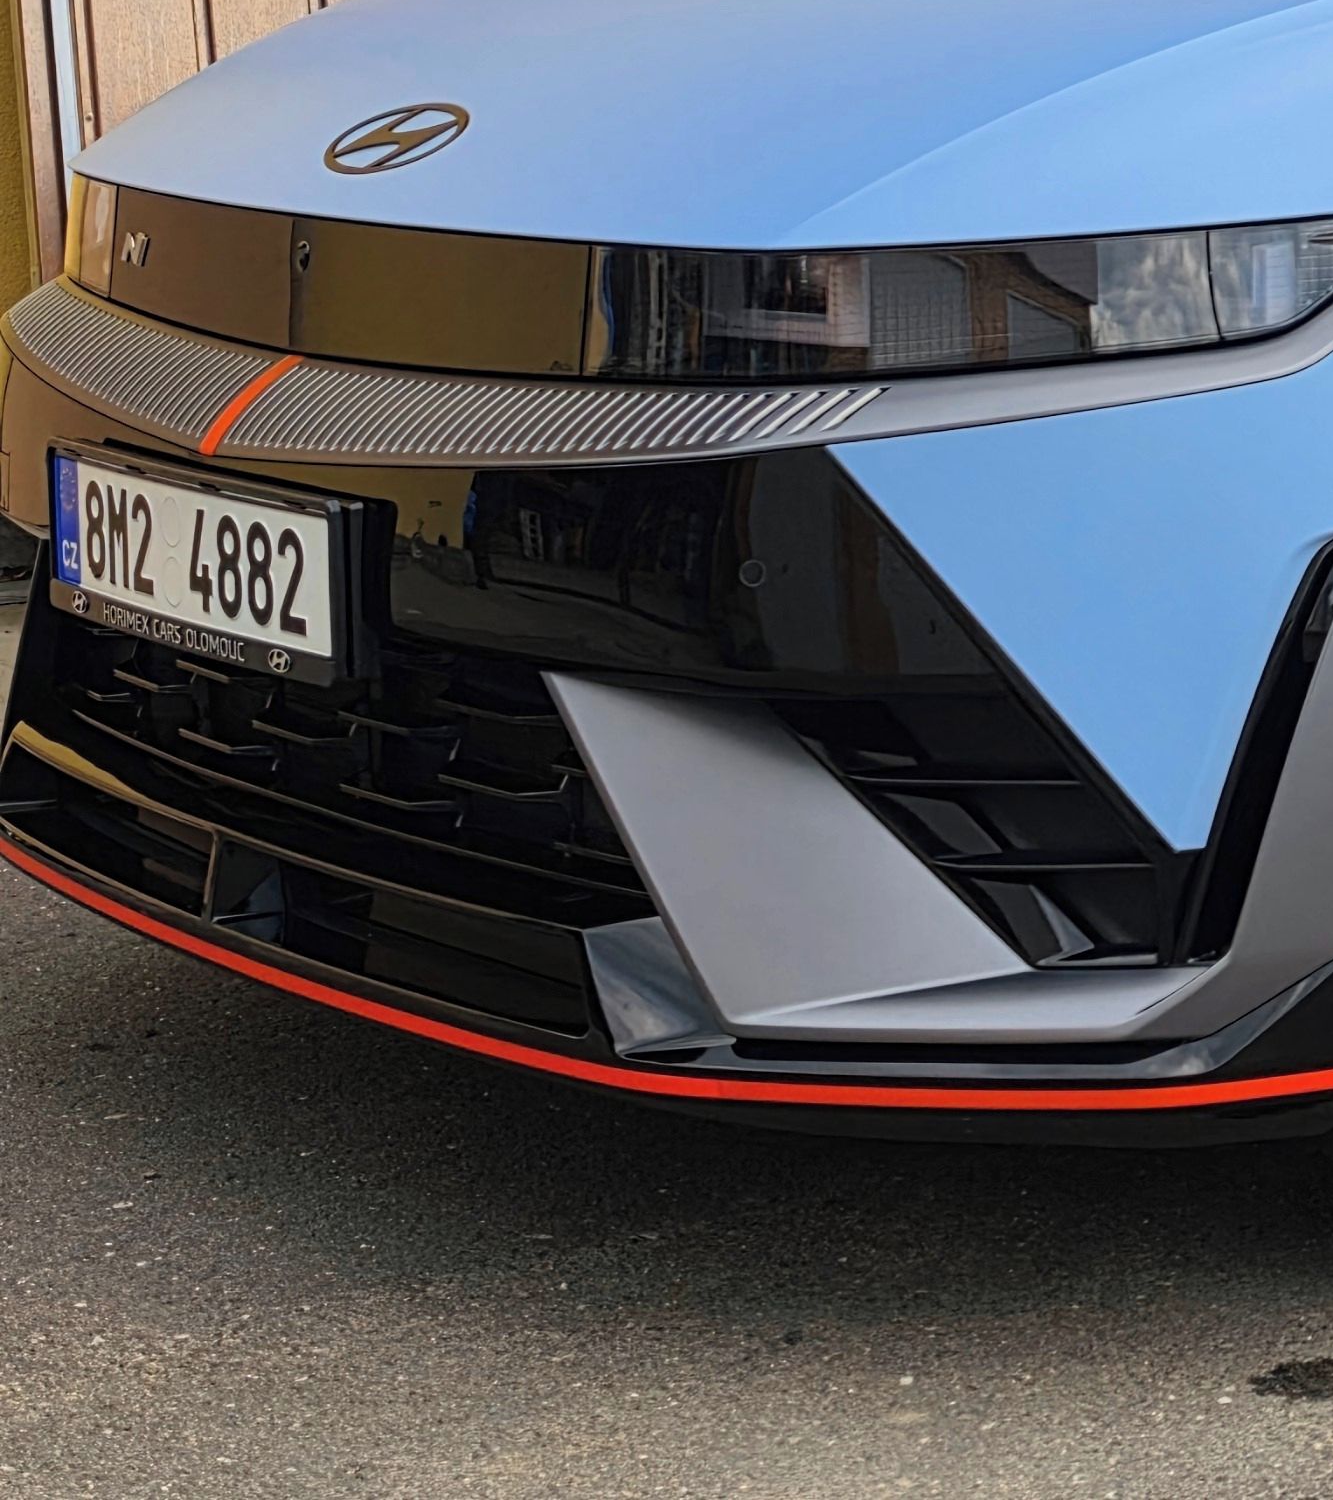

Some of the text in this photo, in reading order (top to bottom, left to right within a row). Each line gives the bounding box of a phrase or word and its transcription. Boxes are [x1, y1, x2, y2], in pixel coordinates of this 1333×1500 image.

[62, 539, 79, 570] CZ
[85, 480, 307, 637] 8M2 4882
[103, 601, 245, 663] HORIMEX CARS OLOMOUC
